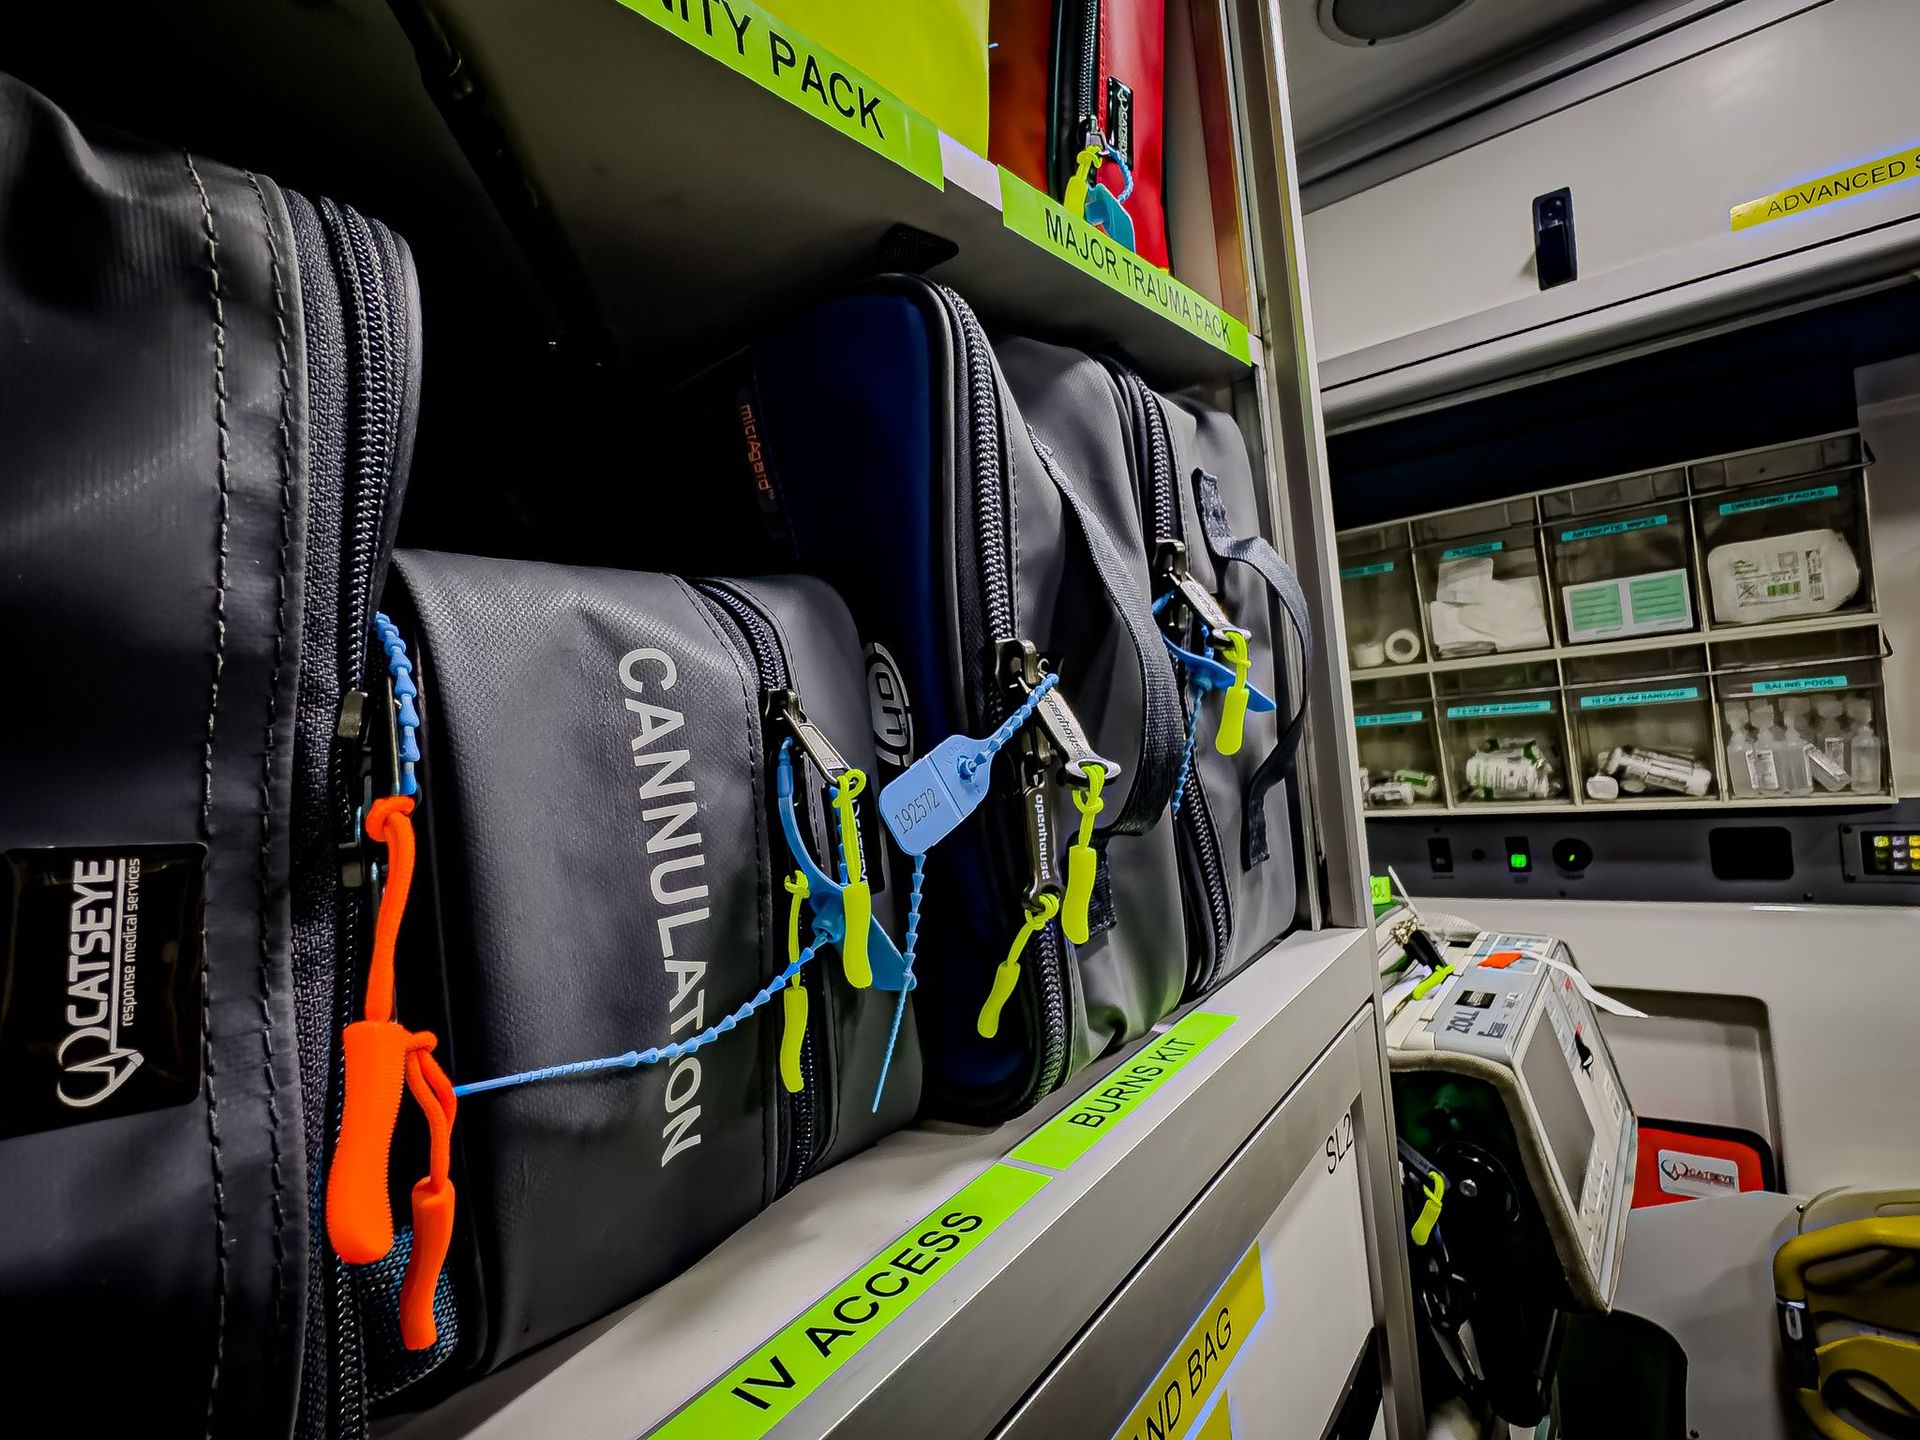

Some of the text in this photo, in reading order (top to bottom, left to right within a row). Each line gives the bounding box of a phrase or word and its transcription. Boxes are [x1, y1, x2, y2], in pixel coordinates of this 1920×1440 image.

[768, 29, 885, 140] PACK
[1767, 161, 1906, 216] ADVANCED
[1045, 207, 1231, 345] MAJOR TRAUMA PACK
[895, 788, 940, 835] 192572
[1035, 794, 1050, 880] openhouse
[66, 860, 115, 1026] CATSEYE
[122, 858, 140, 1028] response medical services
[619, 647, 709, 1168] CANNULATON
[1067, 1038, 1195, 1128] BURNS KIT
[1326, 1113, 1353, 1175] SL2
[731, 1212, 983, 1410] IV ACCESS
[1133, 1307, 1231, 1440] ND BAG
